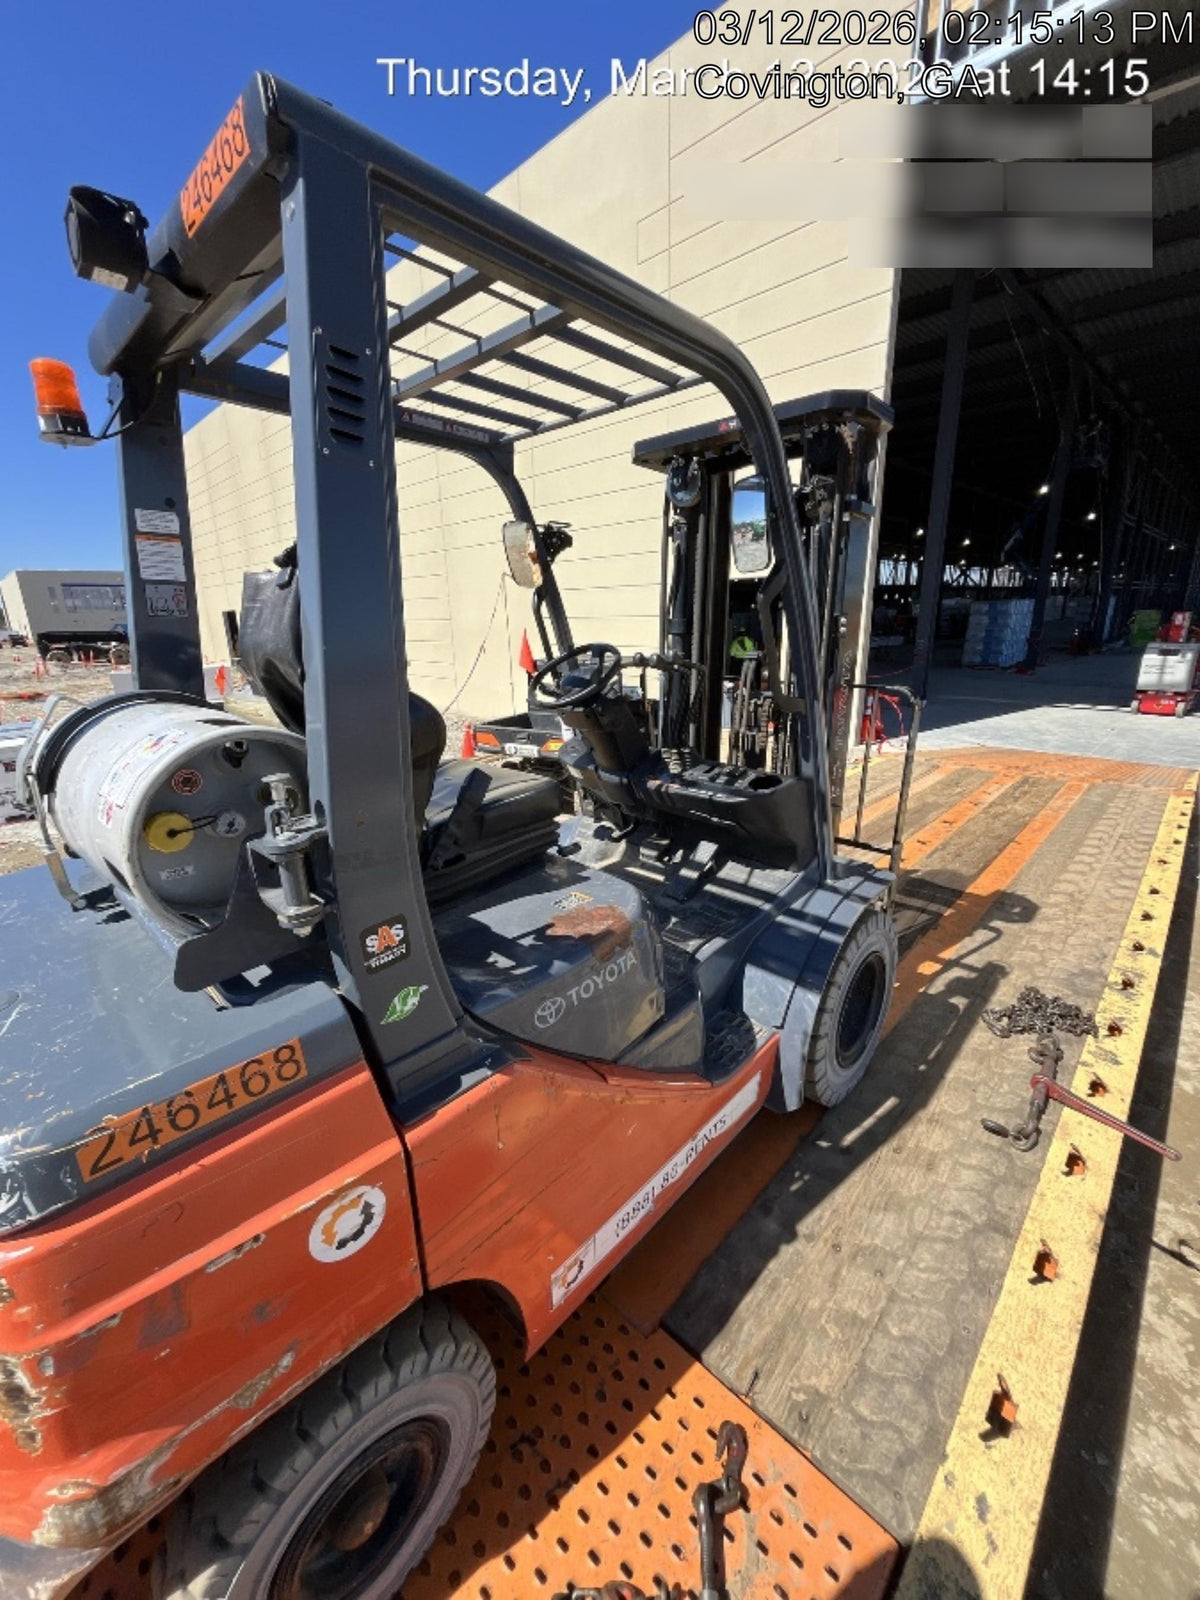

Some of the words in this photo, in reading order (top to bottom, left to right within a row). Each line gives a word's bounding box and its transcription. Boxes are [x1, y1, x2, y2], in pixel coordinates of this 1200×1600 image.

[182, 103, 247, 229] 246468
[566, 948, 637, 1007] TOYOTA
[85, 1043, 303, 1178] 246468
